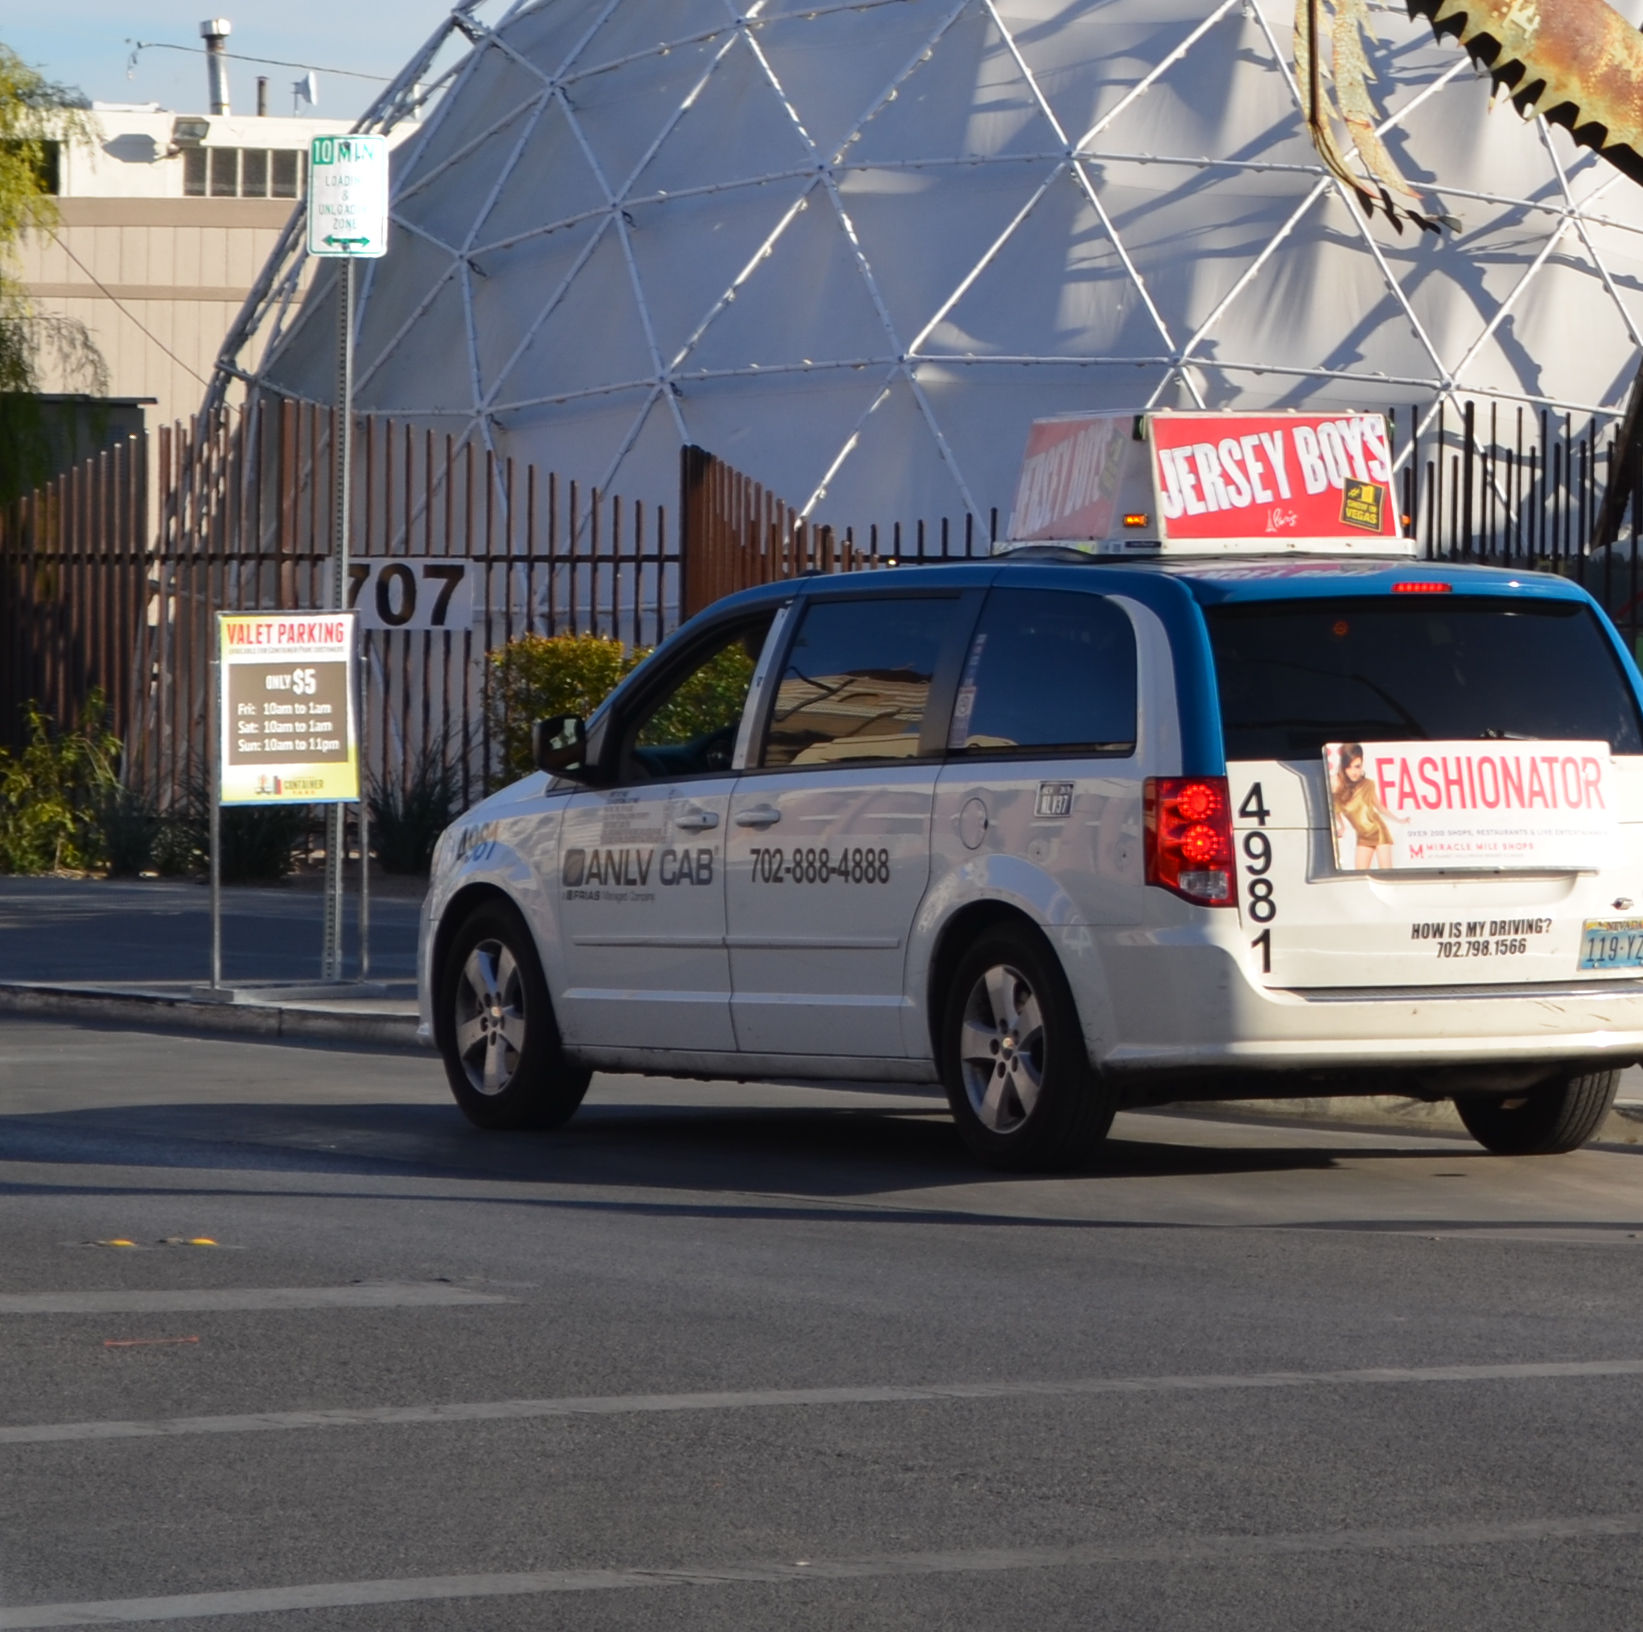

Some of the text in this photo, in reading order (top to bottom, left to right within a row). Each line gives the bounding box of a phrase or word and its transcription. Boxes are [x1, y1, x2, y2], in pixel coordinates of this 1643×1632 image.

[313, 139, 333, 163] 10
[332, 218, 357, 230] ZONE
[1158, 415, 1390, 520] JERSEY BOYS
[1345, 507, 1378, 525] VEGAS
[347, 562, 465, 626] 707
[226, 622, 344, 645] VALET PARKING
[265, 668, 316, 695] ONLY $5
[237, 701, 332, 716] Fri: 10am to 1am
[237, 719, 333, 734] Sat: 10am to 1am
[237, 737, 340, 753] Sun: 10am to 11pm
[1374, 755, 1606, 811] FASHIONATOR
[1426, 843, 1471, 851] MIRACLE
[584, 848, 714, 886] ANLV CAB
[748, 847, 891, 885] 702-888-4888
[1410, 918, 1553, 940] HOW IS MY DRIVING?
[1606, 919, 1643, 931] NEVADA
[1436, 937, 1528, 959] 702.798.1566
